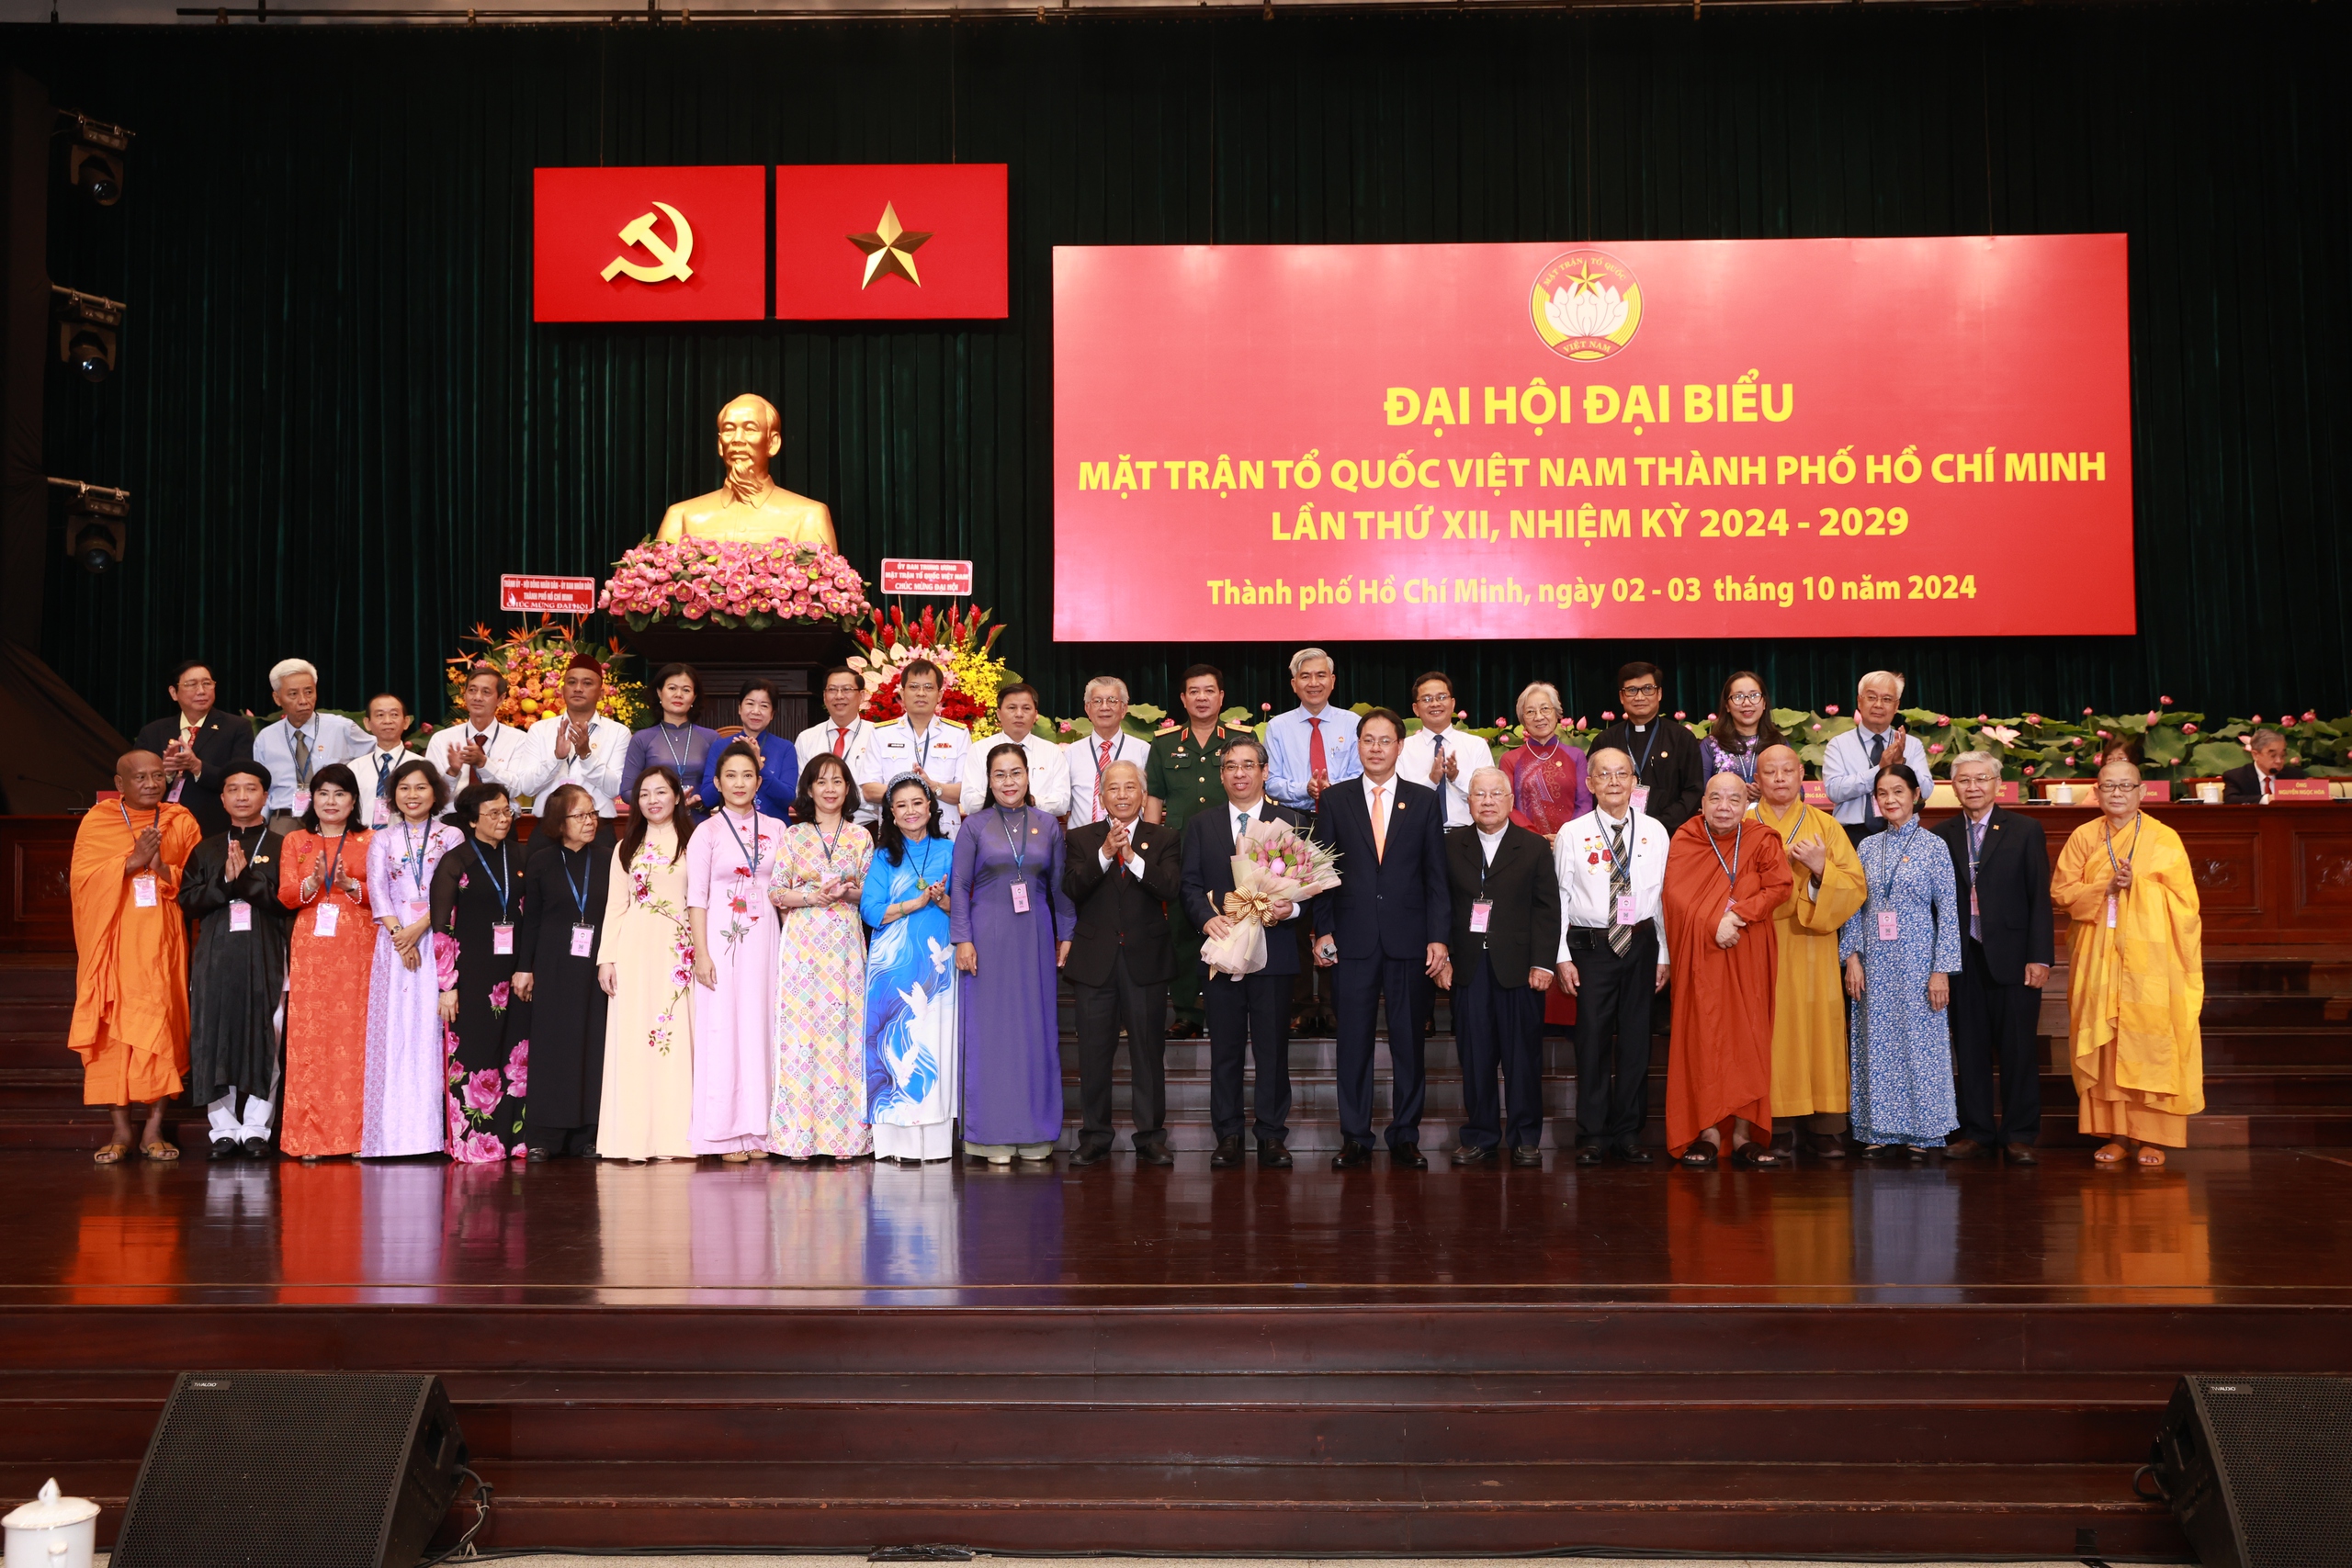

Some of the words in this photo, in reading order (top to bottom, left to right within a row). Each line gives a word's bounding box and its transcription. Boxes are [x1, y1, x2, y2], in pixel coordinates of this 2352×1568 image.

[1543, 268, 1559, 287] MẶT
[1558, 257, 1583, 271] TRẬN
[1603, 262, 1627, 281] QUỐC
[1563, 340, 1587, 353] VIỆT
[1589, 341, 1611, 353] NAM
[1383, 387, 1470, 438] ĐẠI
[1484, 377, 1571, 437] HỘI
[1582, 384, 1670, 436] ĐẠI
[1683, 367, 1793, 423] BIỂU
[1078, 453, 1158, 500] MẶT
[1163, 453, 1264, 499] TRẬN
[1271, 448, 1322, 490] TỔ
[1330, 448, 1441, 493] QUỐC
[1447, 451, 1531, 497] VIỆT
[1539, 457, 1627, 487] NAM
[1634, 449, 1767, 486] THÀNH
[1776, 445, 1857, 485] PHỐ
[1866, 444, 1922, 484] HỒ
[1931, 446, 1996, 483] CHÍ
[2005, 452, 2106, 482] MINH
[1272, 502, 1346, 541] LẦN
[1352, 503, 1435, 540] THỨ
[1442, 510, 1500, 543] XII,
[1510, 502, 1632, 547] NHIỆM
[1641, 502, 1690, 538] KỲ
[1700, 508, 1790, 537] 2024
[1819, 506, 1909, 536] 2029
[1206, 578, 1293, 605] Thành
[1299, 574, 1353, 612] phố
[1359, 578, 1396, 604] Hồ
[1403, 578, 1446, 604] Chí
[1454, 577, 1532, 606] Minh,
[1538, 576, 1606, 610] ngày
[1611, 577, 1645, 603] 02
[1668, 577, 1702, 602] 03
[1713, 575, 1794, 608] tháng
[1802, 576, 1835, 601] 10
[1841, 574, 1901, 600] năm
[1907, 574, 1977, 600] 2024
